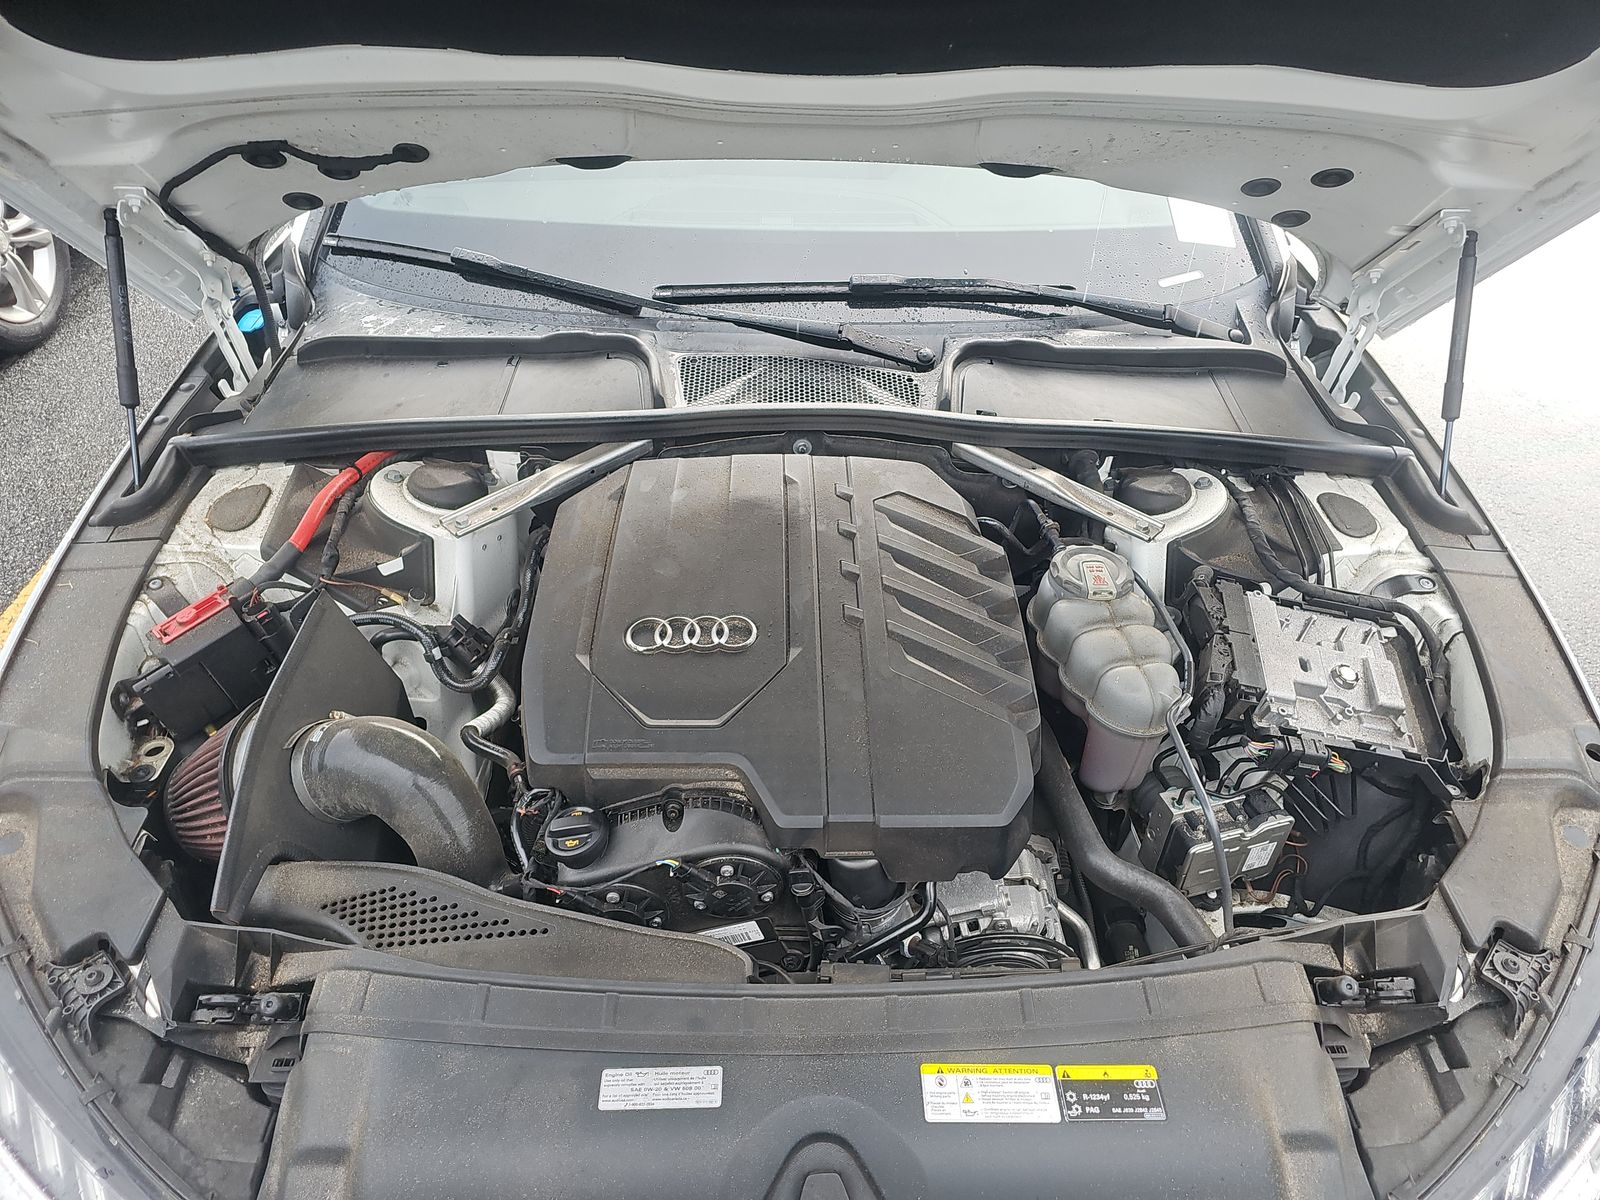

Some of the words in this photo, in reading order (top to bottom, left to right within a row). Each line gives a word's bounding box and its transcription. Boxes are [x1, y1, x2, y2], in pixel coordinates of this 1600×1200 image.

[1082, 1093, 1110, 1102] R-1234yf
[1141, 1093, 1150, 1102] kg
[1085, 1106, 1100, 1114] PAG
